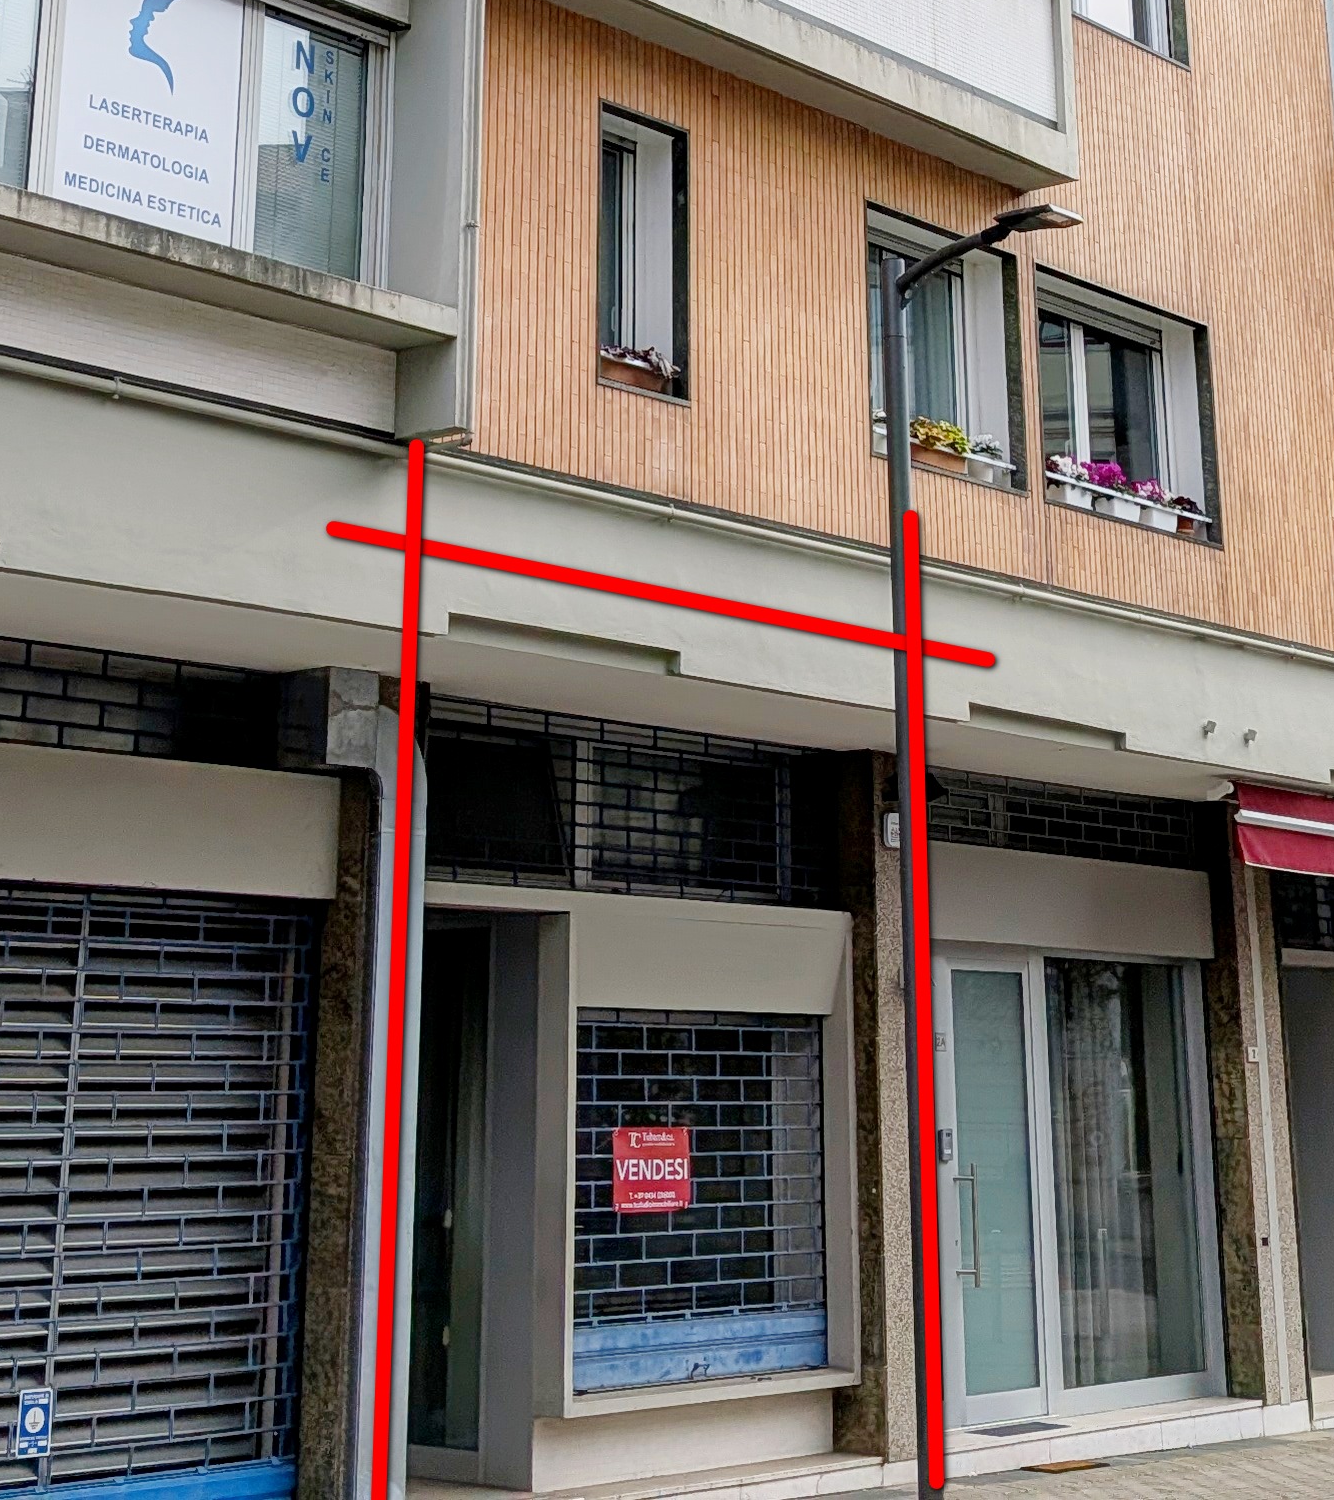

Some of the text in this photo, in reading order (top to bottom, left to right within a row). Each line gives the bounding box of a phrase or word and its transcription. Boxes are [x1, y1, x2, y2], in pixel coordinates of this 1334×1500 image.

[322, 50, 335, 125] SKIN
[88, 93, 210, 144] LASERTERAPIA
[83, 133, 210, 184] DERMATOLOGIA
[63, 170, 222, 229] MEDICINA ESTETICA
[616, 1158, 688, 1180] VENDESI
